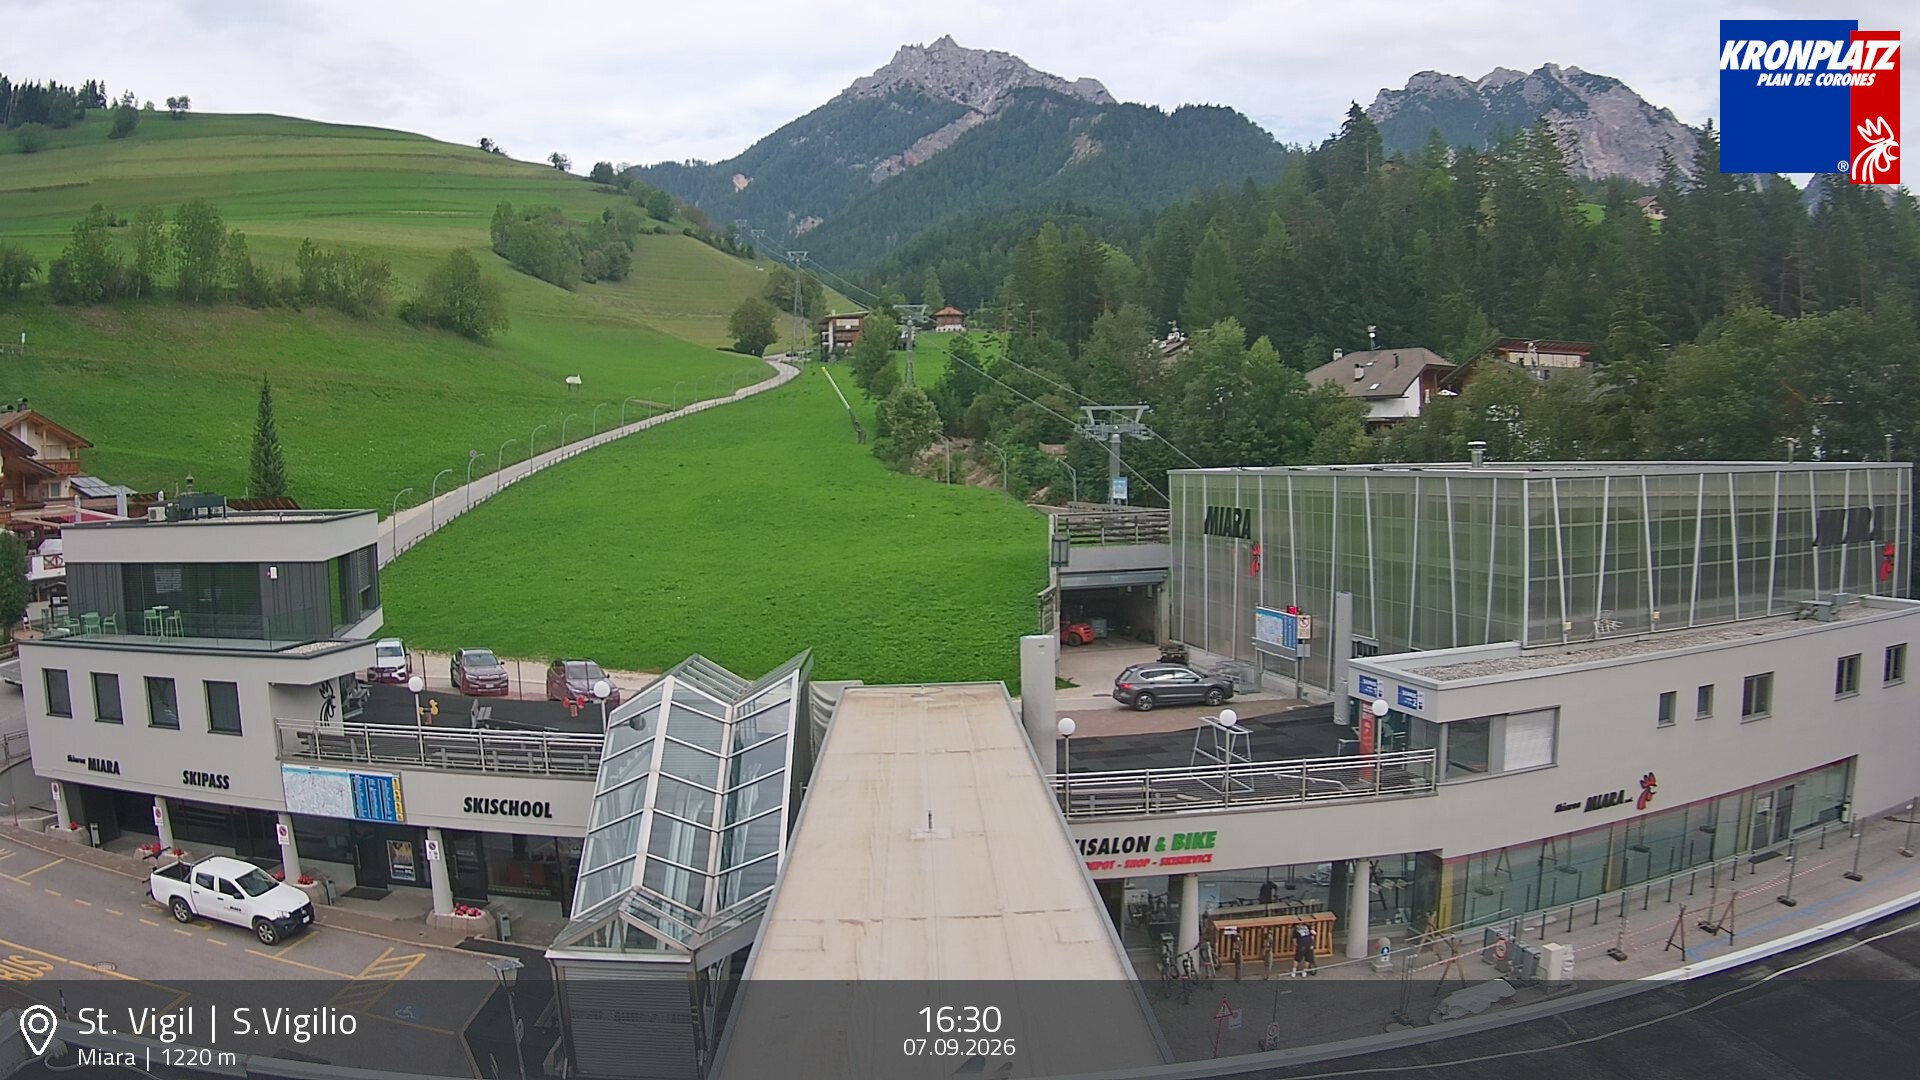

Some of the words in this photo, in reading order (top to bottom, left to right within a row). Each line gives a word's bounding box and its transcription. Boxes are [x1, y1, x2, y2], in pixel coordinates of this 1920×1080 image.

[1203, 505, 1251, 539] MIARA
[88, 757, 120, 775] MIARA
[182, 770, 230, 790] SKIPASS
[463, 797, 553, 819] SKISCHOOL
[1583, 789, 1625, 813] MIARA
[1075, 835, 1151, 856] ISALON
[1154, 836, 1166, 852] &
[1171, 830, 1217, 851] BIKE
